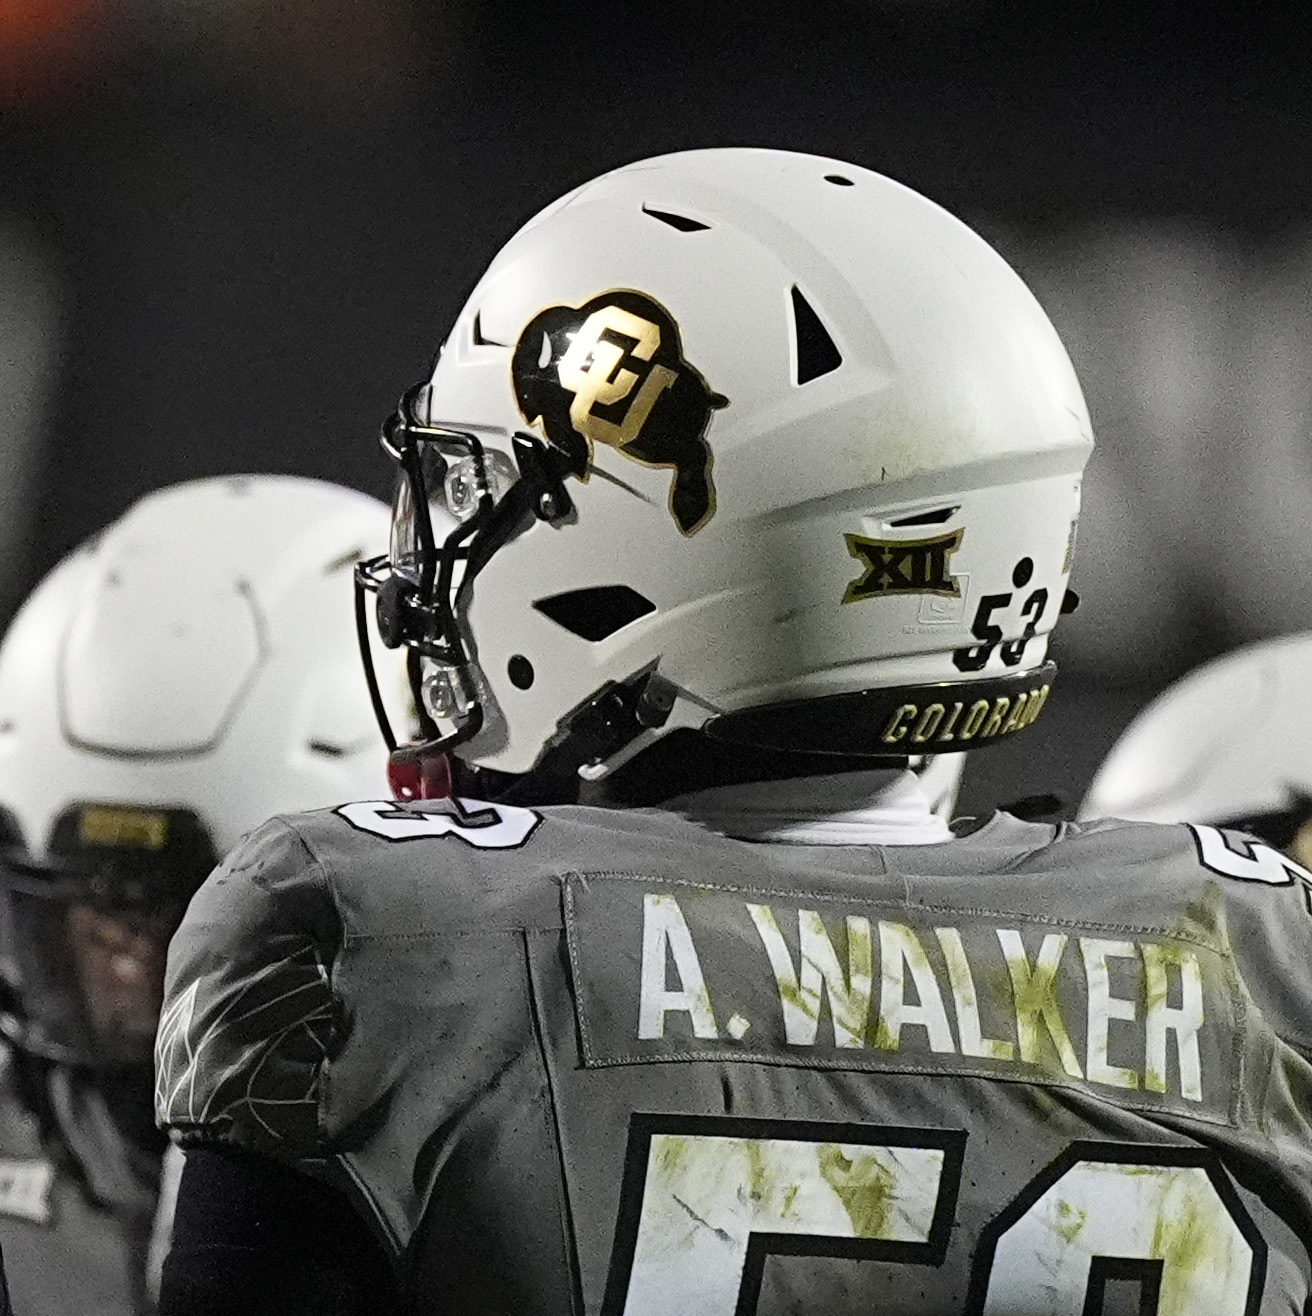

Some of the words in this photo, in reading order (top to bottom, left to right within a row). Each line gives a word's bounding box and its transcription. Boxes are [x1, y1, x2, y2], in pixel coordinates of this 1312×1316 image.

[852, 534, 960, 596] XII
[953, 588, 1048, 672] 53
[637, 892, 751, 1042] A.
[745, 901, 1204, 1103] WALKER
